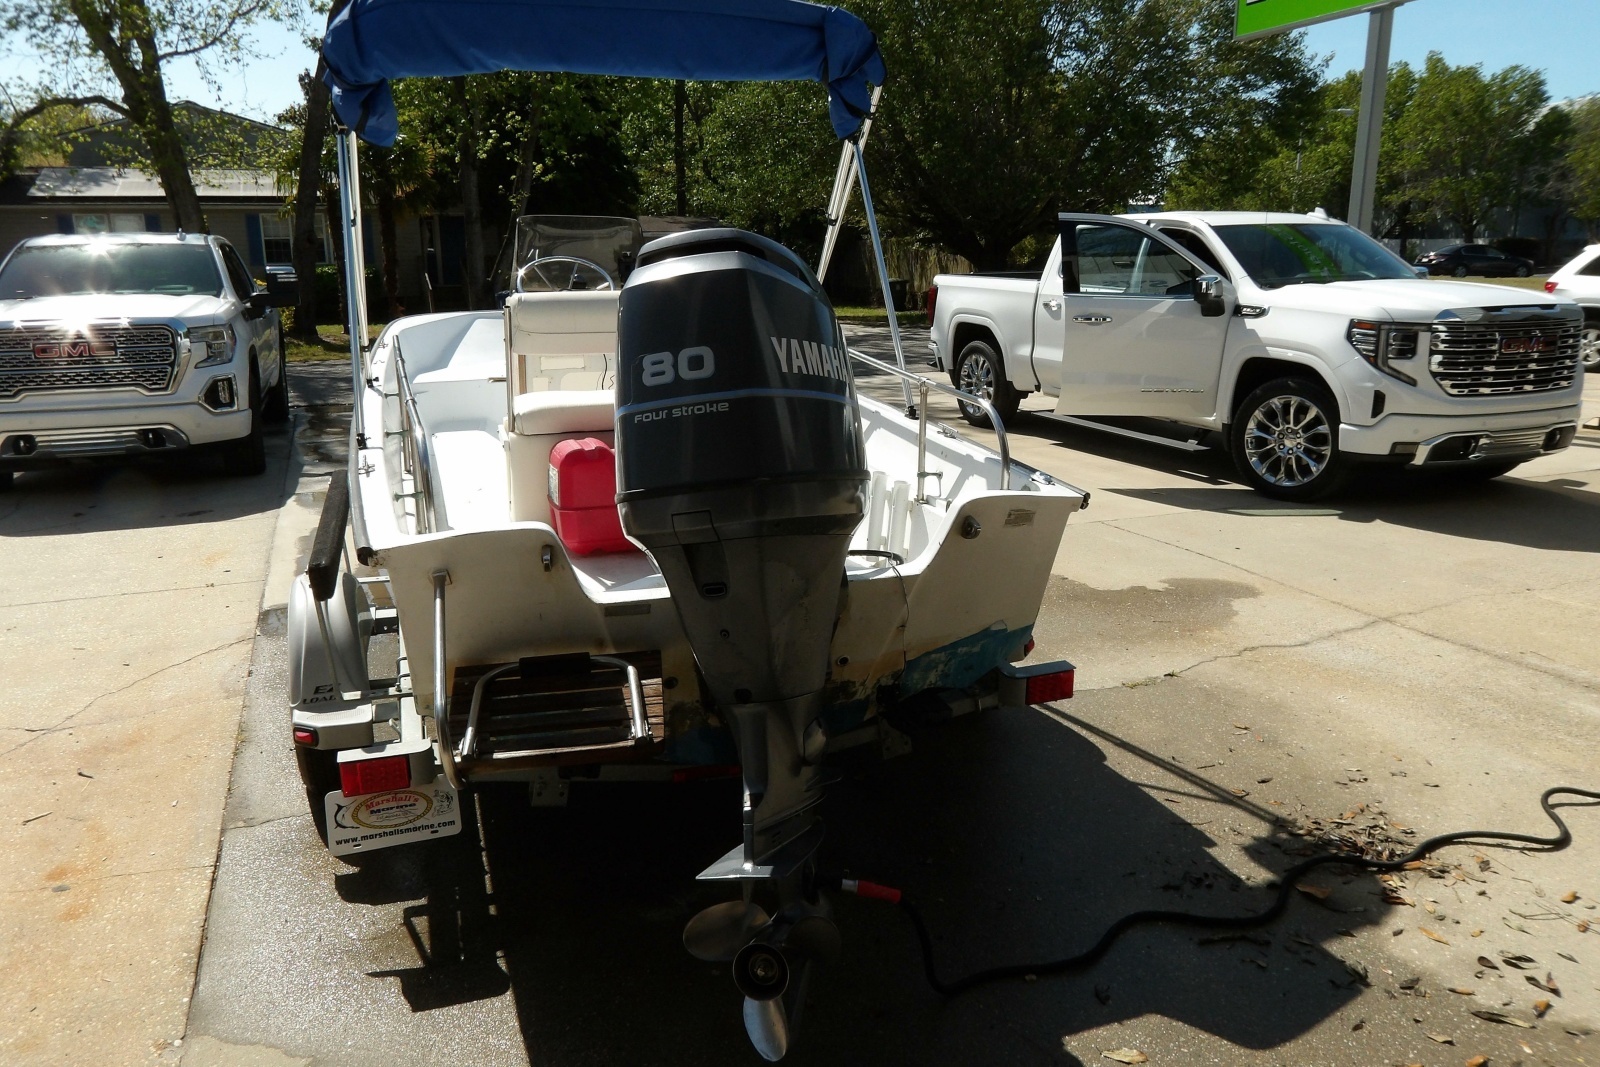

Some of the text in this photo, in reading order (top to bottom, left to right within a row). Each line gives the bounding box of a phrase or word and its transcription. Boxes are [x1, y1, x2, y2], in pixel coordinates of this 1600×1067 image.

[35, 342, 115, 358] GMC
[770, 336, 849, 383] YAMAHA
[641, 345, 716, 387] 80
[369, 802, 417, 815] Marine
[335, 819, 456, 846] www.marshallsmarine.com
